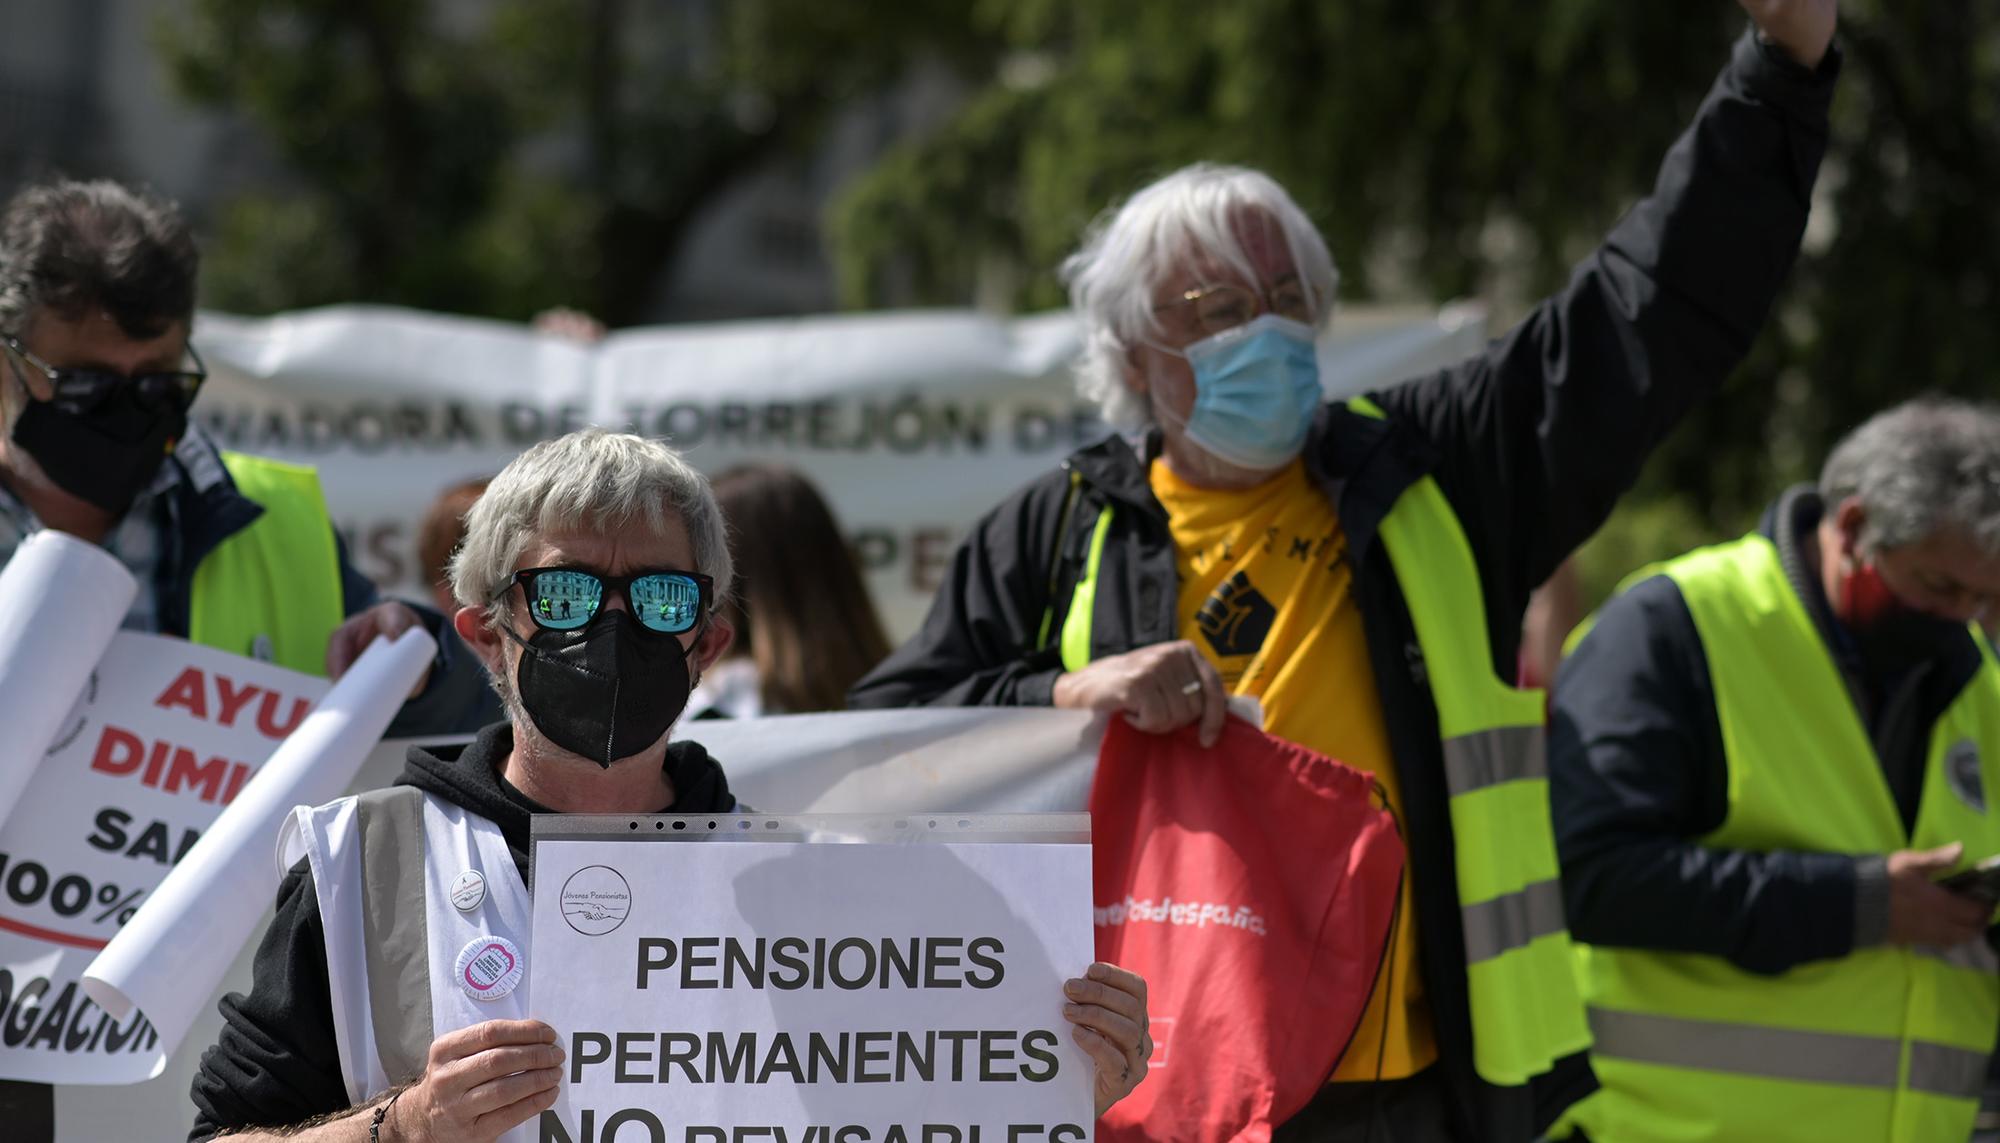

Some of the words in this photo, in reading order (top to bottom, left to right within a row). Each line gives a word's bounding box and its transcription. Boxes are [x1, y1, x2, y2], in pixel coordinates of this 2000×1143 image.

[154, 664, 312, 741] AYU
[590, 891, 628, 899] Pensionistas
[635, 936, 1006, 990] PENSIONES
[569, 1029, 1060, 1085] PERMANENTES
